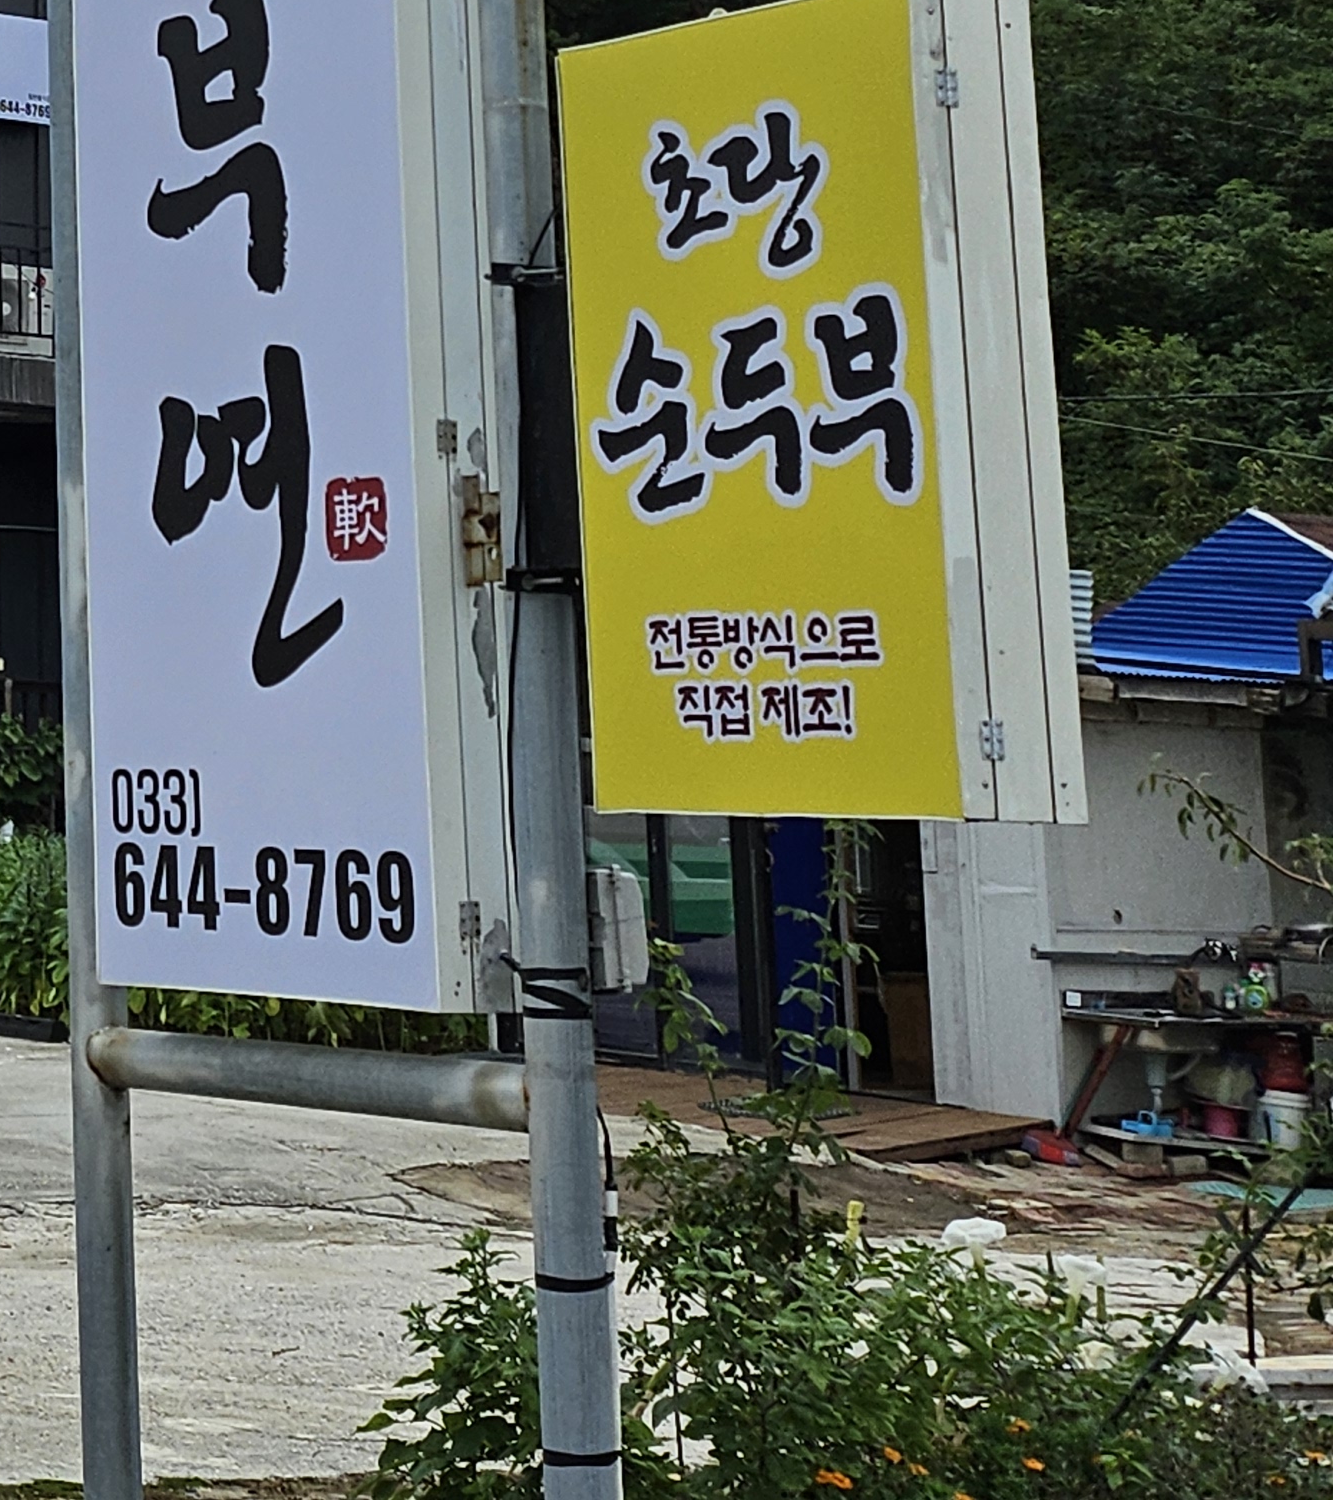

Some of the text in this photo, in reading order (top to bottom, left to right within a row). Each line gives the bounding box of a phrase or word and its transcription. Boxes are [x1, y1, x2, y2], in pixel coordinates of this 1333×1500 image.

[651, 111, 821, 268] 초당
[597, 294, 914, 513] 순두부
[648, 614, 881, 670] 전통방식으로
[677, 684, 853, 738] 직접 제조!
[111, 768, 201, 838] 033)
[114, 841, 415, 944] 644-8769
